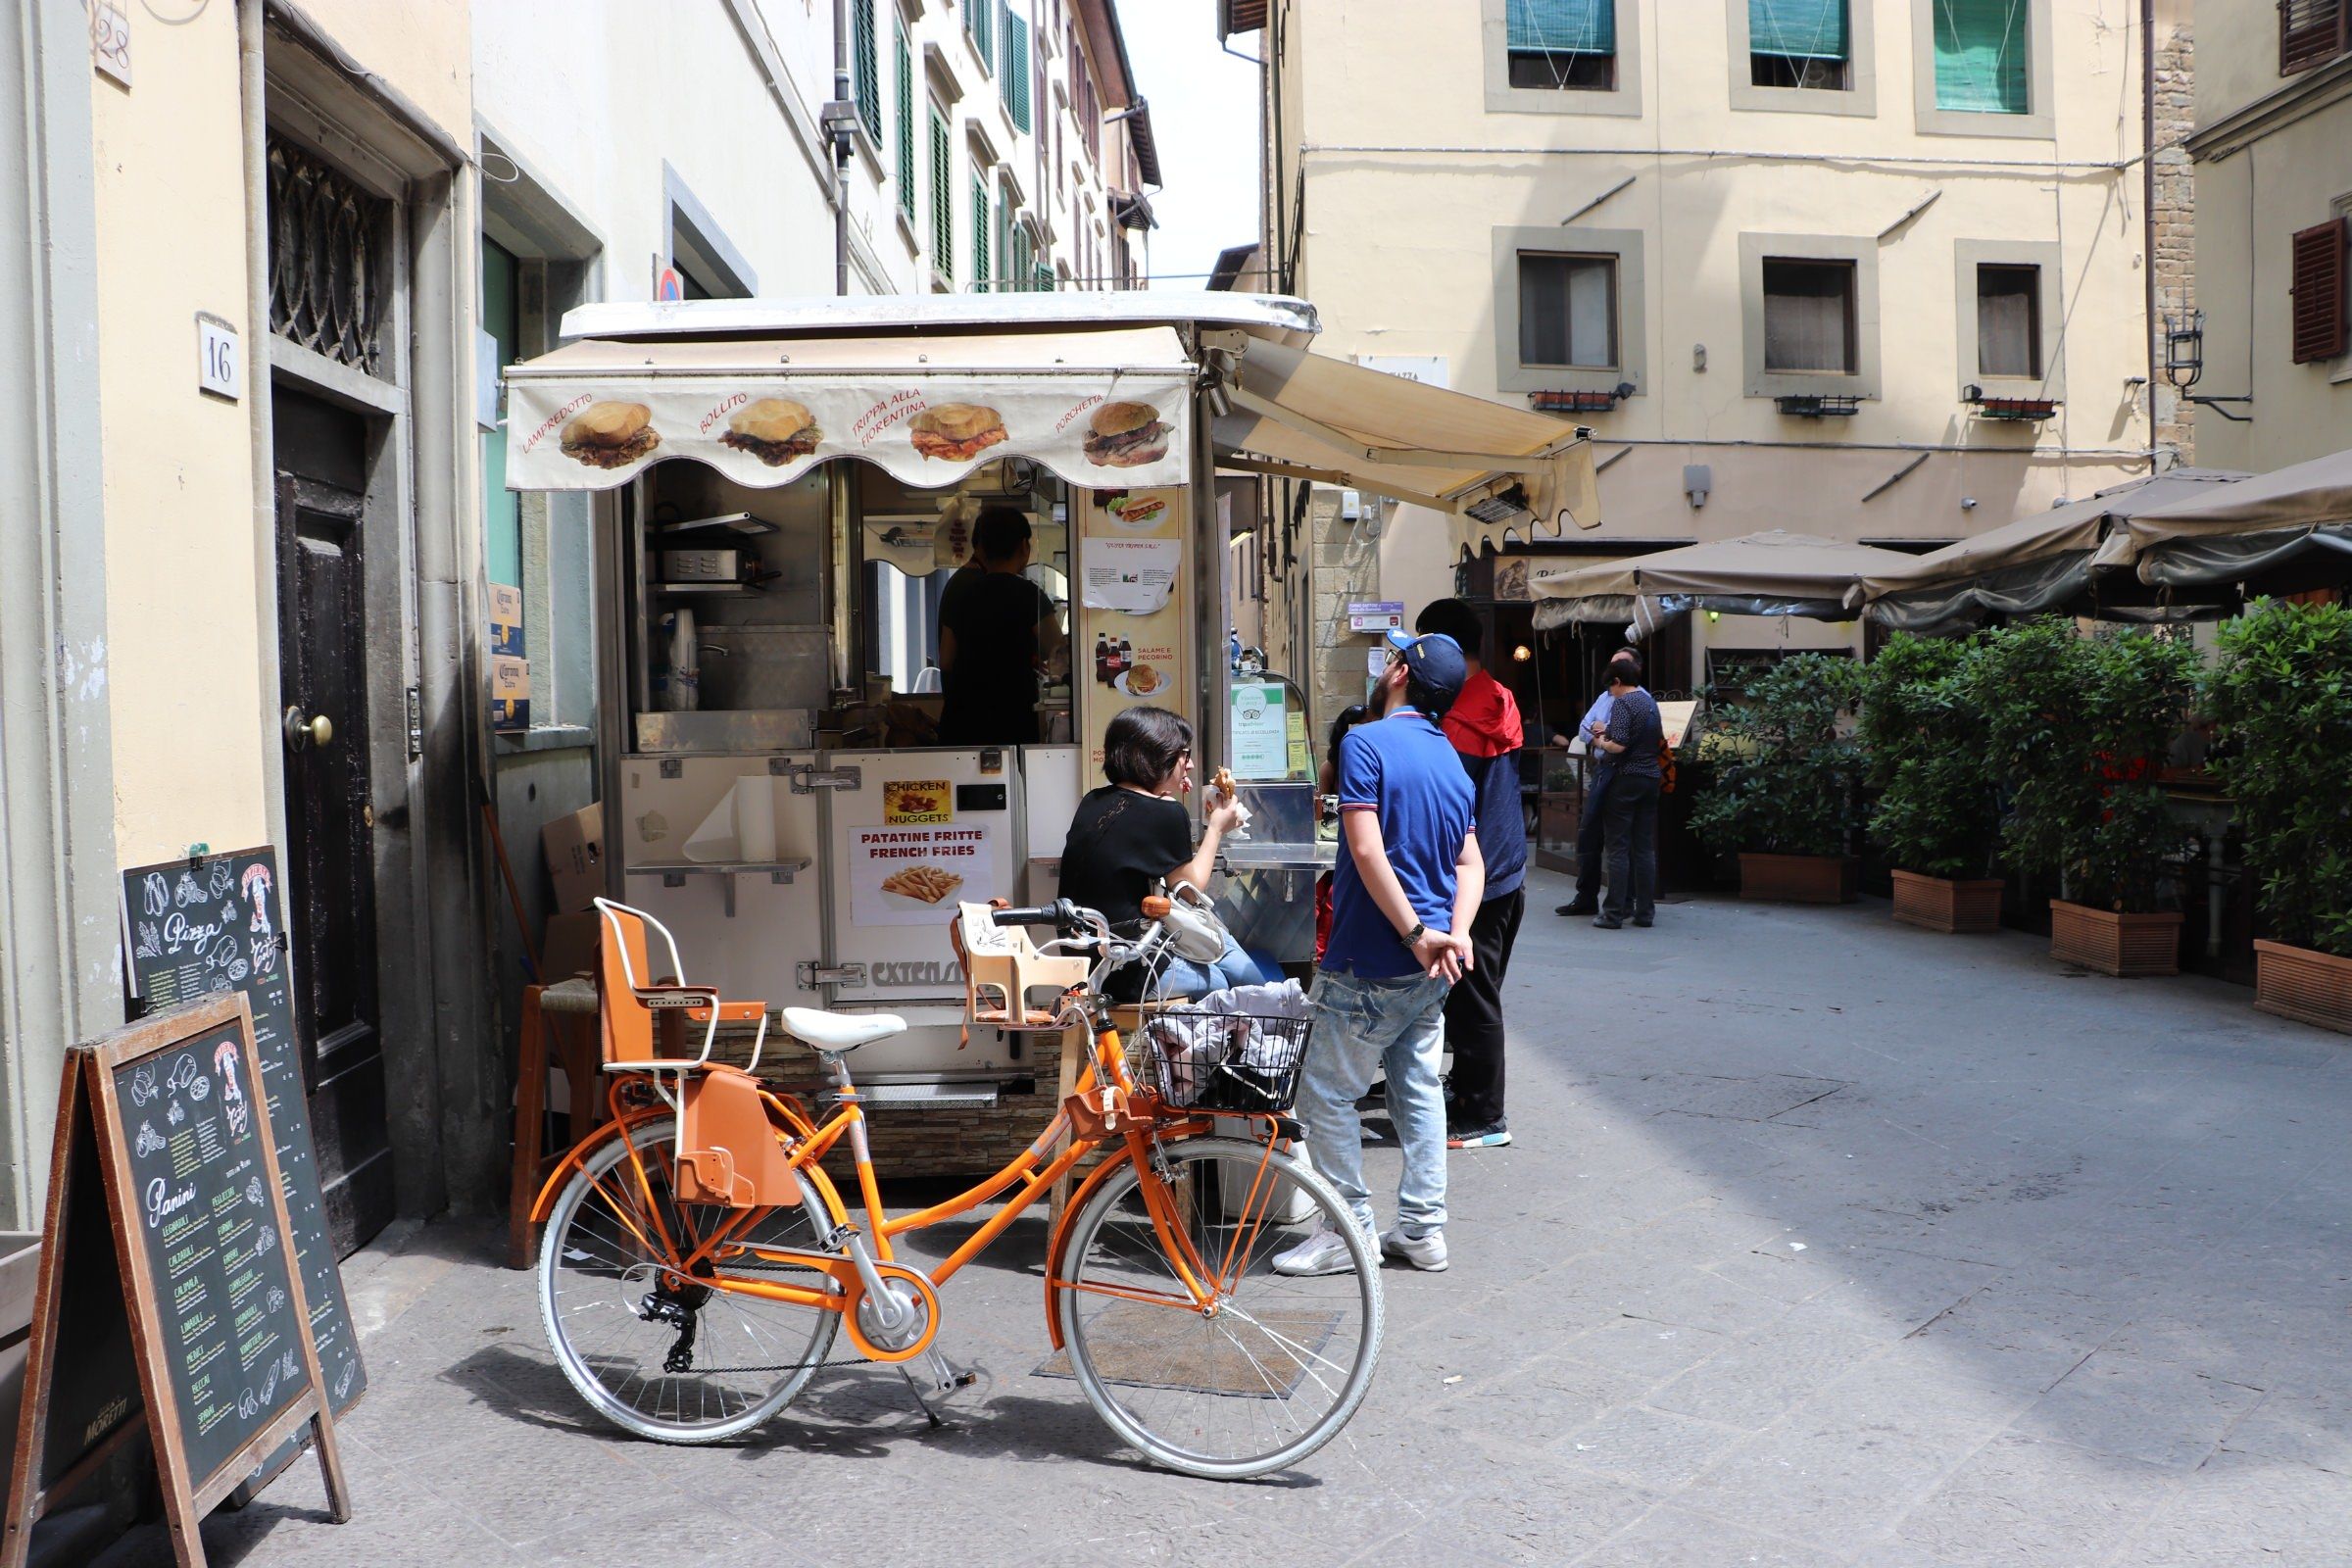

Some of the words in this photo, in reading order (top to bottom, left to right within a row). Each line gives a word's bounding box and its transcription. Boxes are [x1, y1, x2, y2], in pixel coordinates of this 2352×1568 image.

[98, 19, 129, 69] 28
[209, 336, 231, 382] 16
[522, 393, 593, 454] LAMPREDOTTO
[700, 393, 747, 434] BOLLITO
[852, 401, 887, 437] TRIPPA
[891, 388, 921, 407] ALLA
[861, 401, 926, 448] FIORENTINA
[1055, 394, 1103, 434] PORCHETTA
[497, 590, 512, 604] Corona
[499, 663, 519, 679] Corona
[887, 781, 946, 792] CHICKEN
[861, 832, 930, 844] PATATINE
[934, 830, 983, 841] FRITTE
[888, 813, 949, 824] NUGGETS
[869, 847, 927, 858] FRENCH
[932, 845, 975, 857] FRIES
[164, 911, 223, 955] Pizza
[145, 1177, 196, 1228] Panini
[84, 1396, 127, 1446] MORETTI
